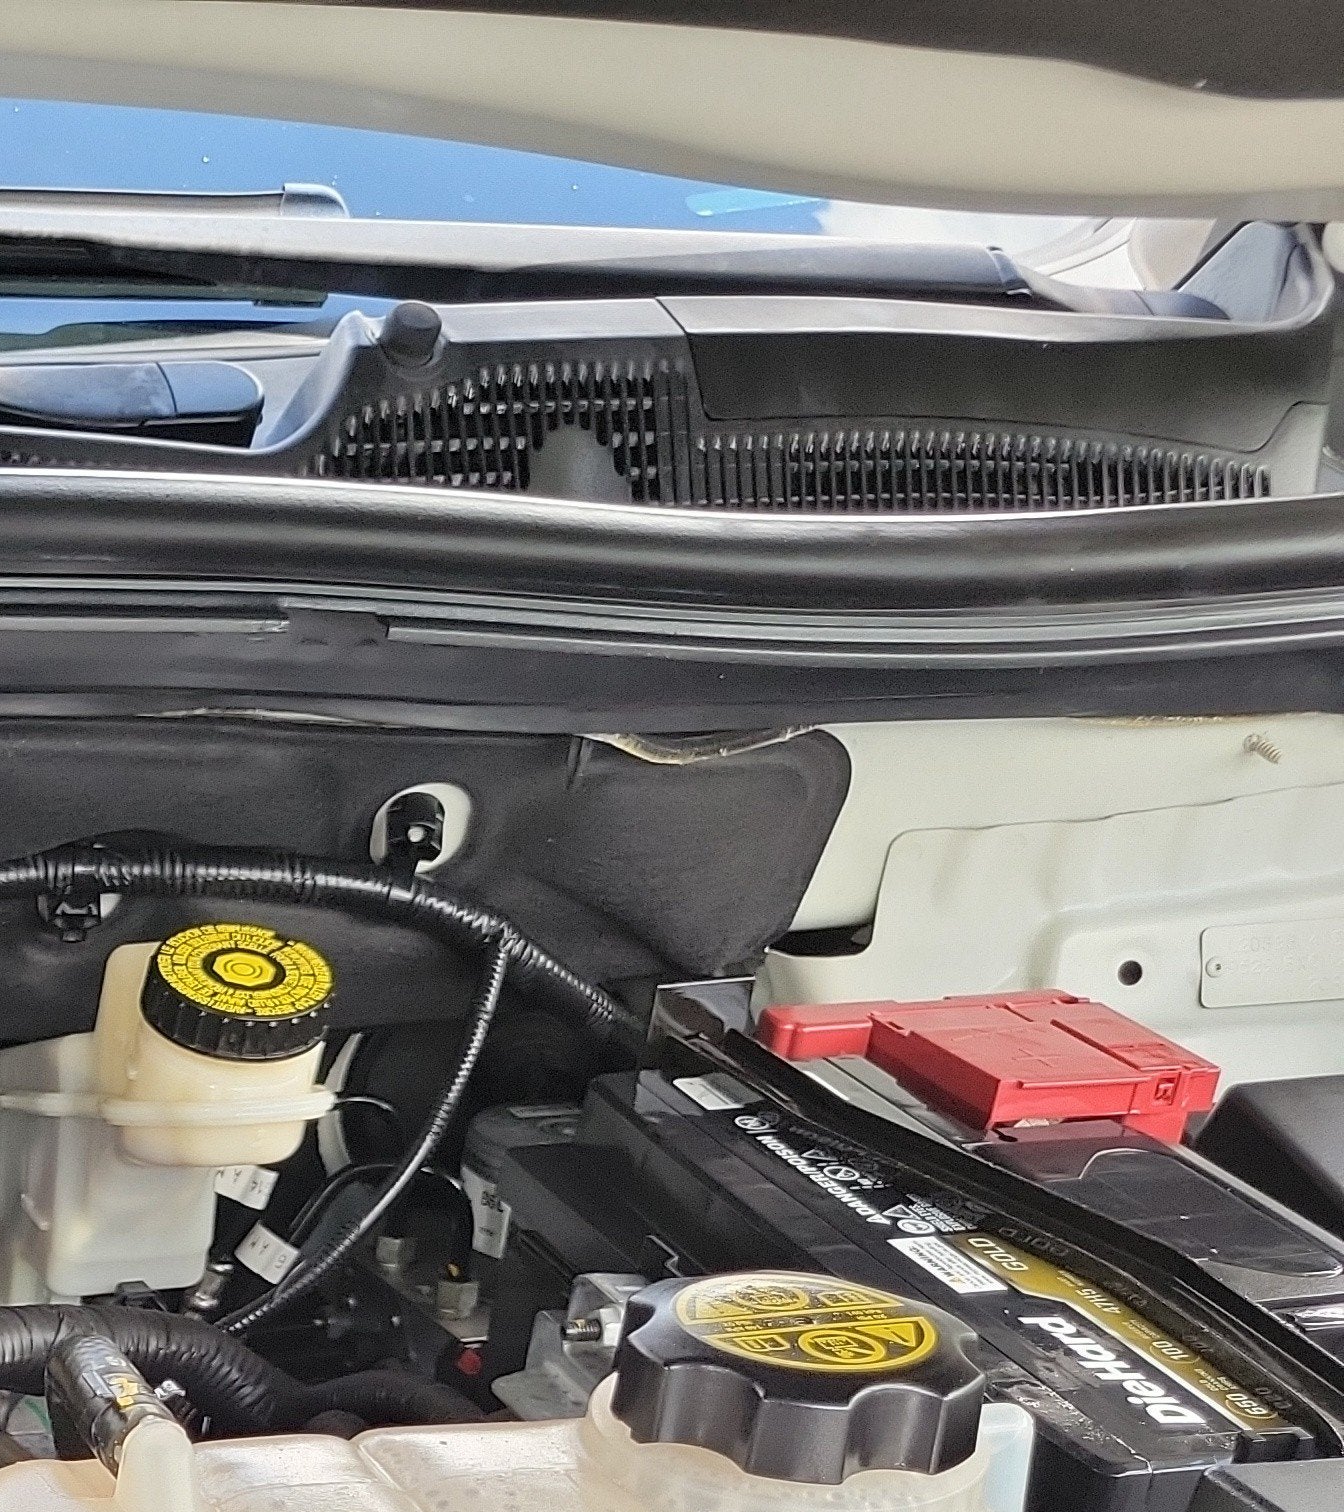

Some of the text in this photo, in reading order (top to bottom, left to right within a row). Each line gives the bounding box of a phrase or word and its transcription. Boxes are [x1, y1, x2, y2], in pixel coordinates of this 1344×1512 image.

[755, 1135, 878, 1215] DANGER/POISON
[968, 1237, 1029, 1271] GOLD
[1152, 1340, 1189, 1359] 100
[1014, 1315, 1211, 1423] DieHard
[1225, 1393, 1269, 1414] 650
